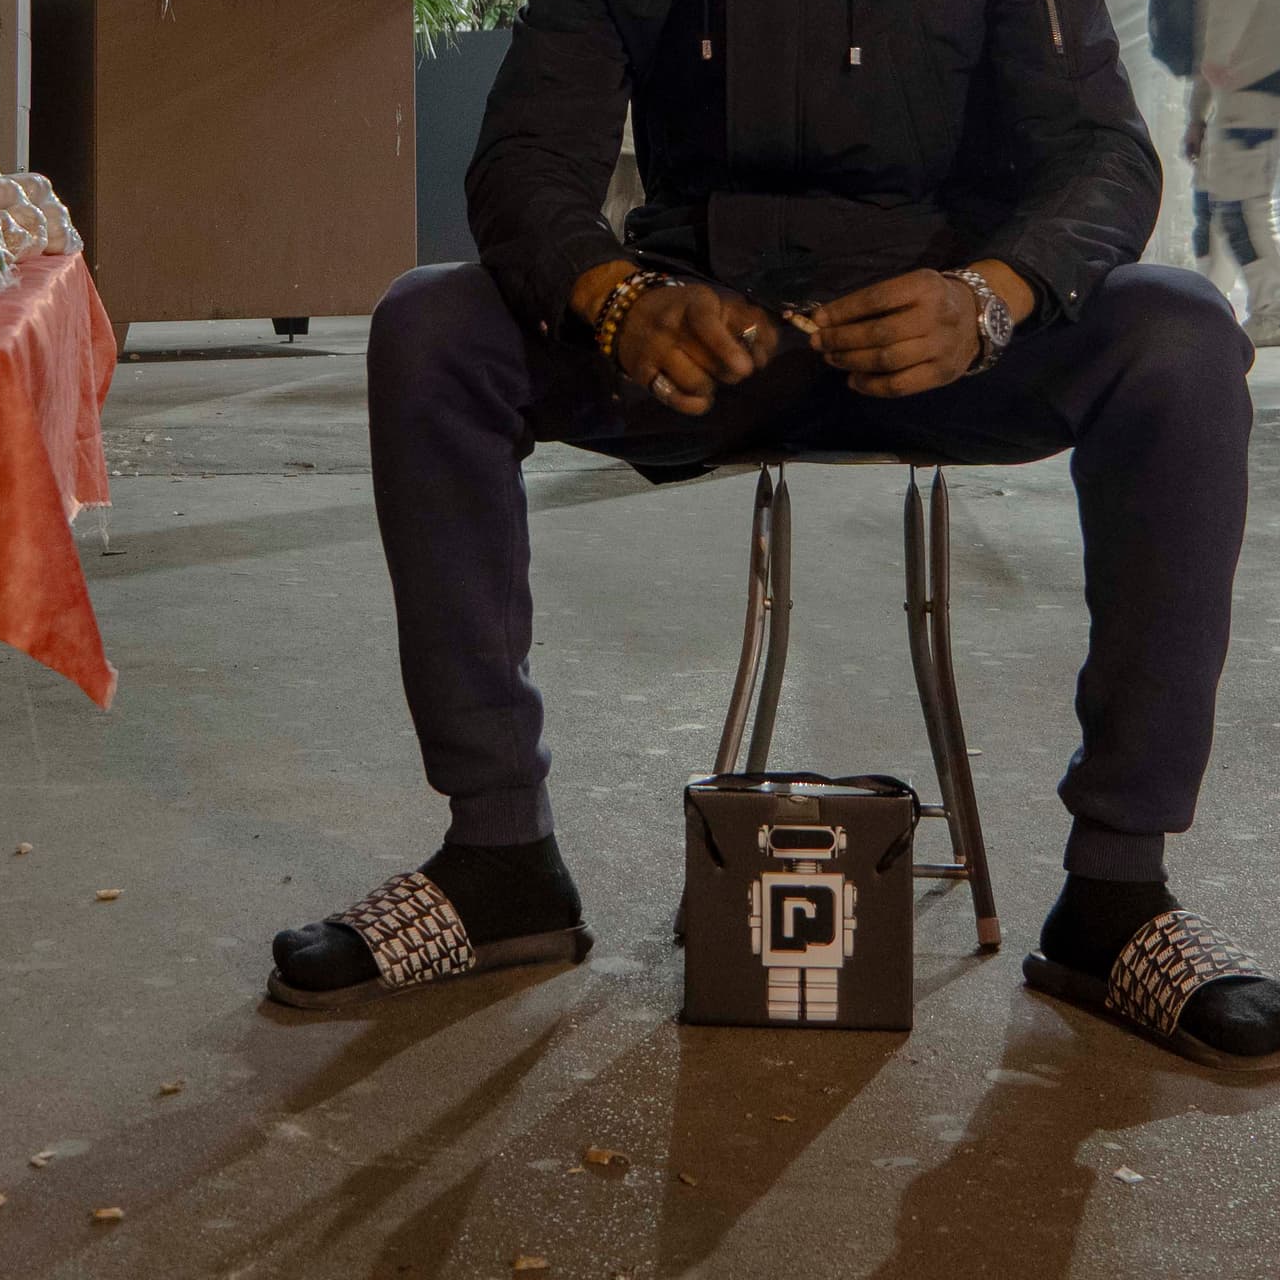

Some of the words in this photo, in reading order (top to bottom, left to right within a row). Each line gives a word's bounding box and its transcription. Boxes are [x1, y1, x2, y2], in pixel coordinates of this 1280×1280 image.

[1145, 931, 1162, 952] NIKE
[1157, 946, 1175, 965] NIKE
[1169, 960, 1187, 979] NIKE
[1181, 975, 1201, 994] NIKE
